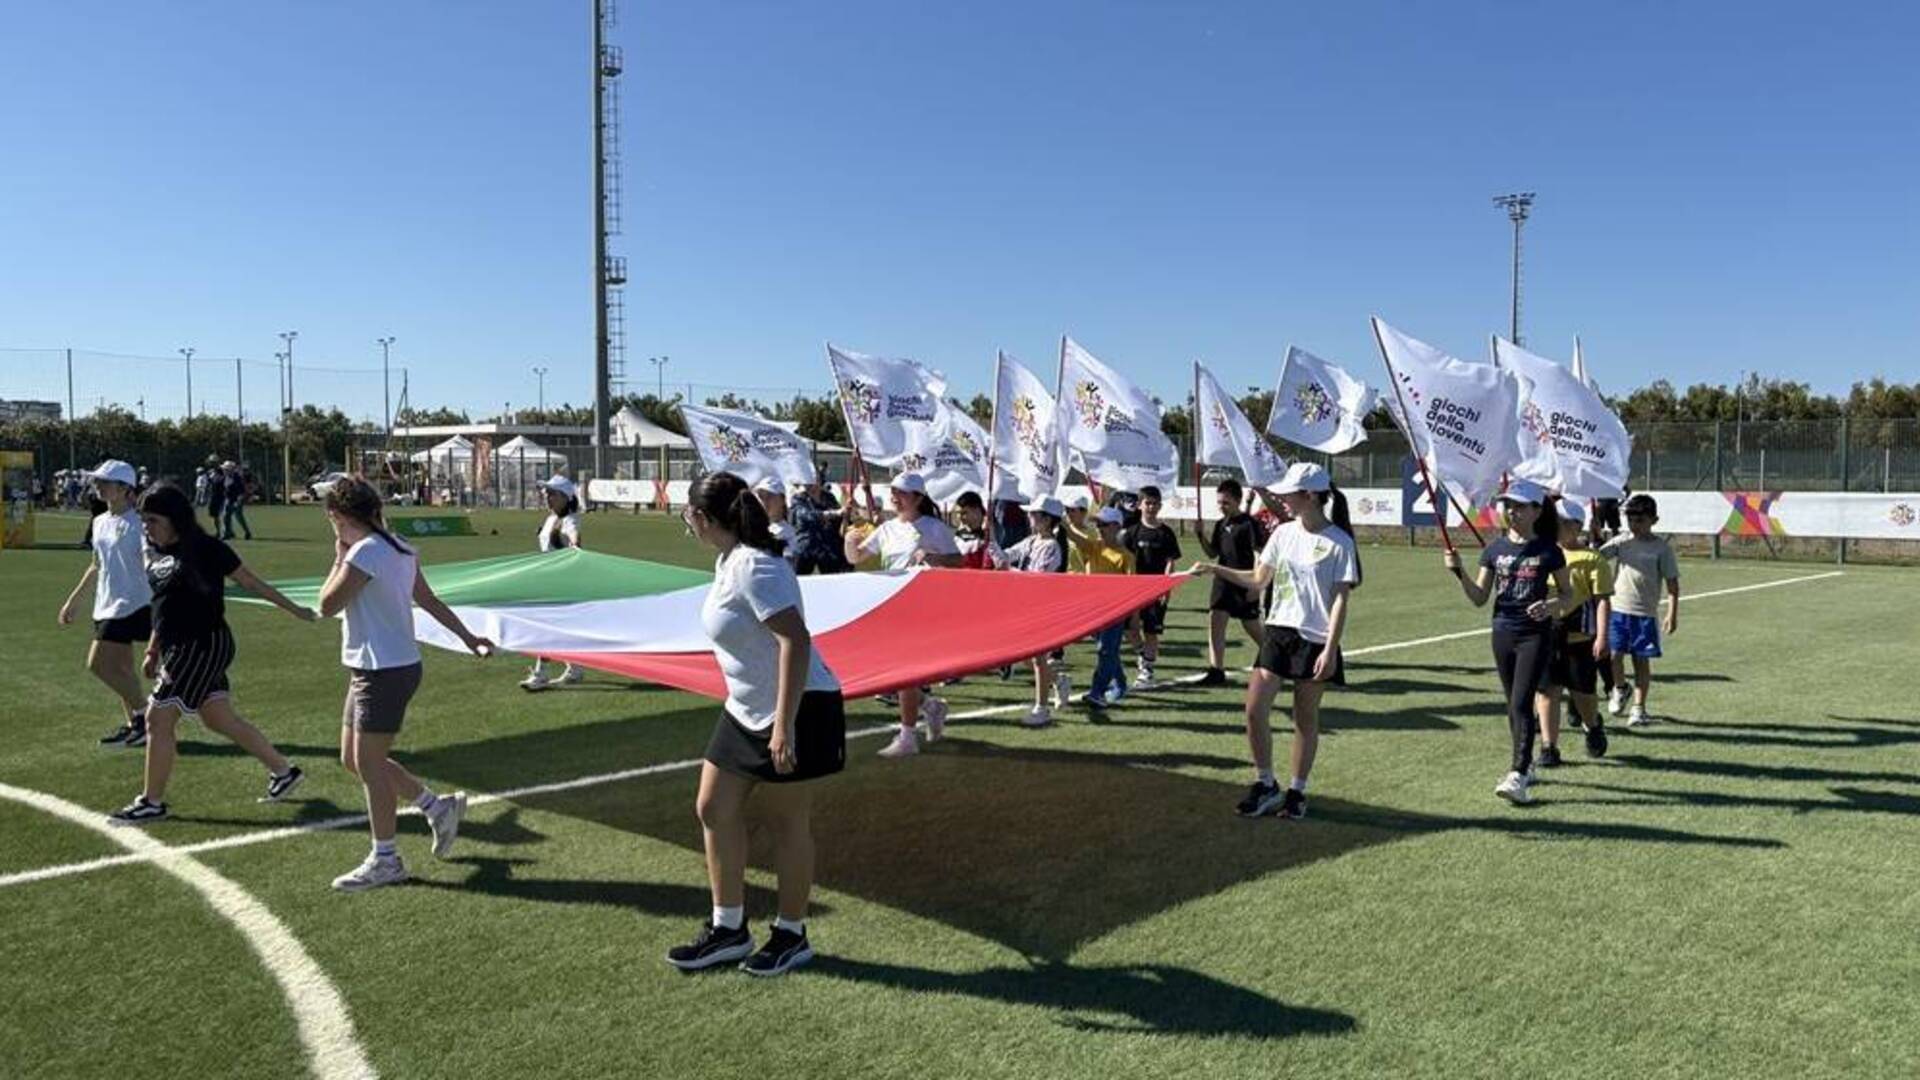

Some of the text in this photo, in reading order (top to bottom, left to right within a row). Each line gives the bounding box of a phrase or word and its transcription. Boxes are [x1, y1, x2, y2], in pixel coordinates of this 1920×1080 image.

[1426, 409, 1465, 432] della
[1430, 398, 1481, 423] giochi
[1550, 424, 1583, 441] della
[1551, 412, 1597, 433] giochi
